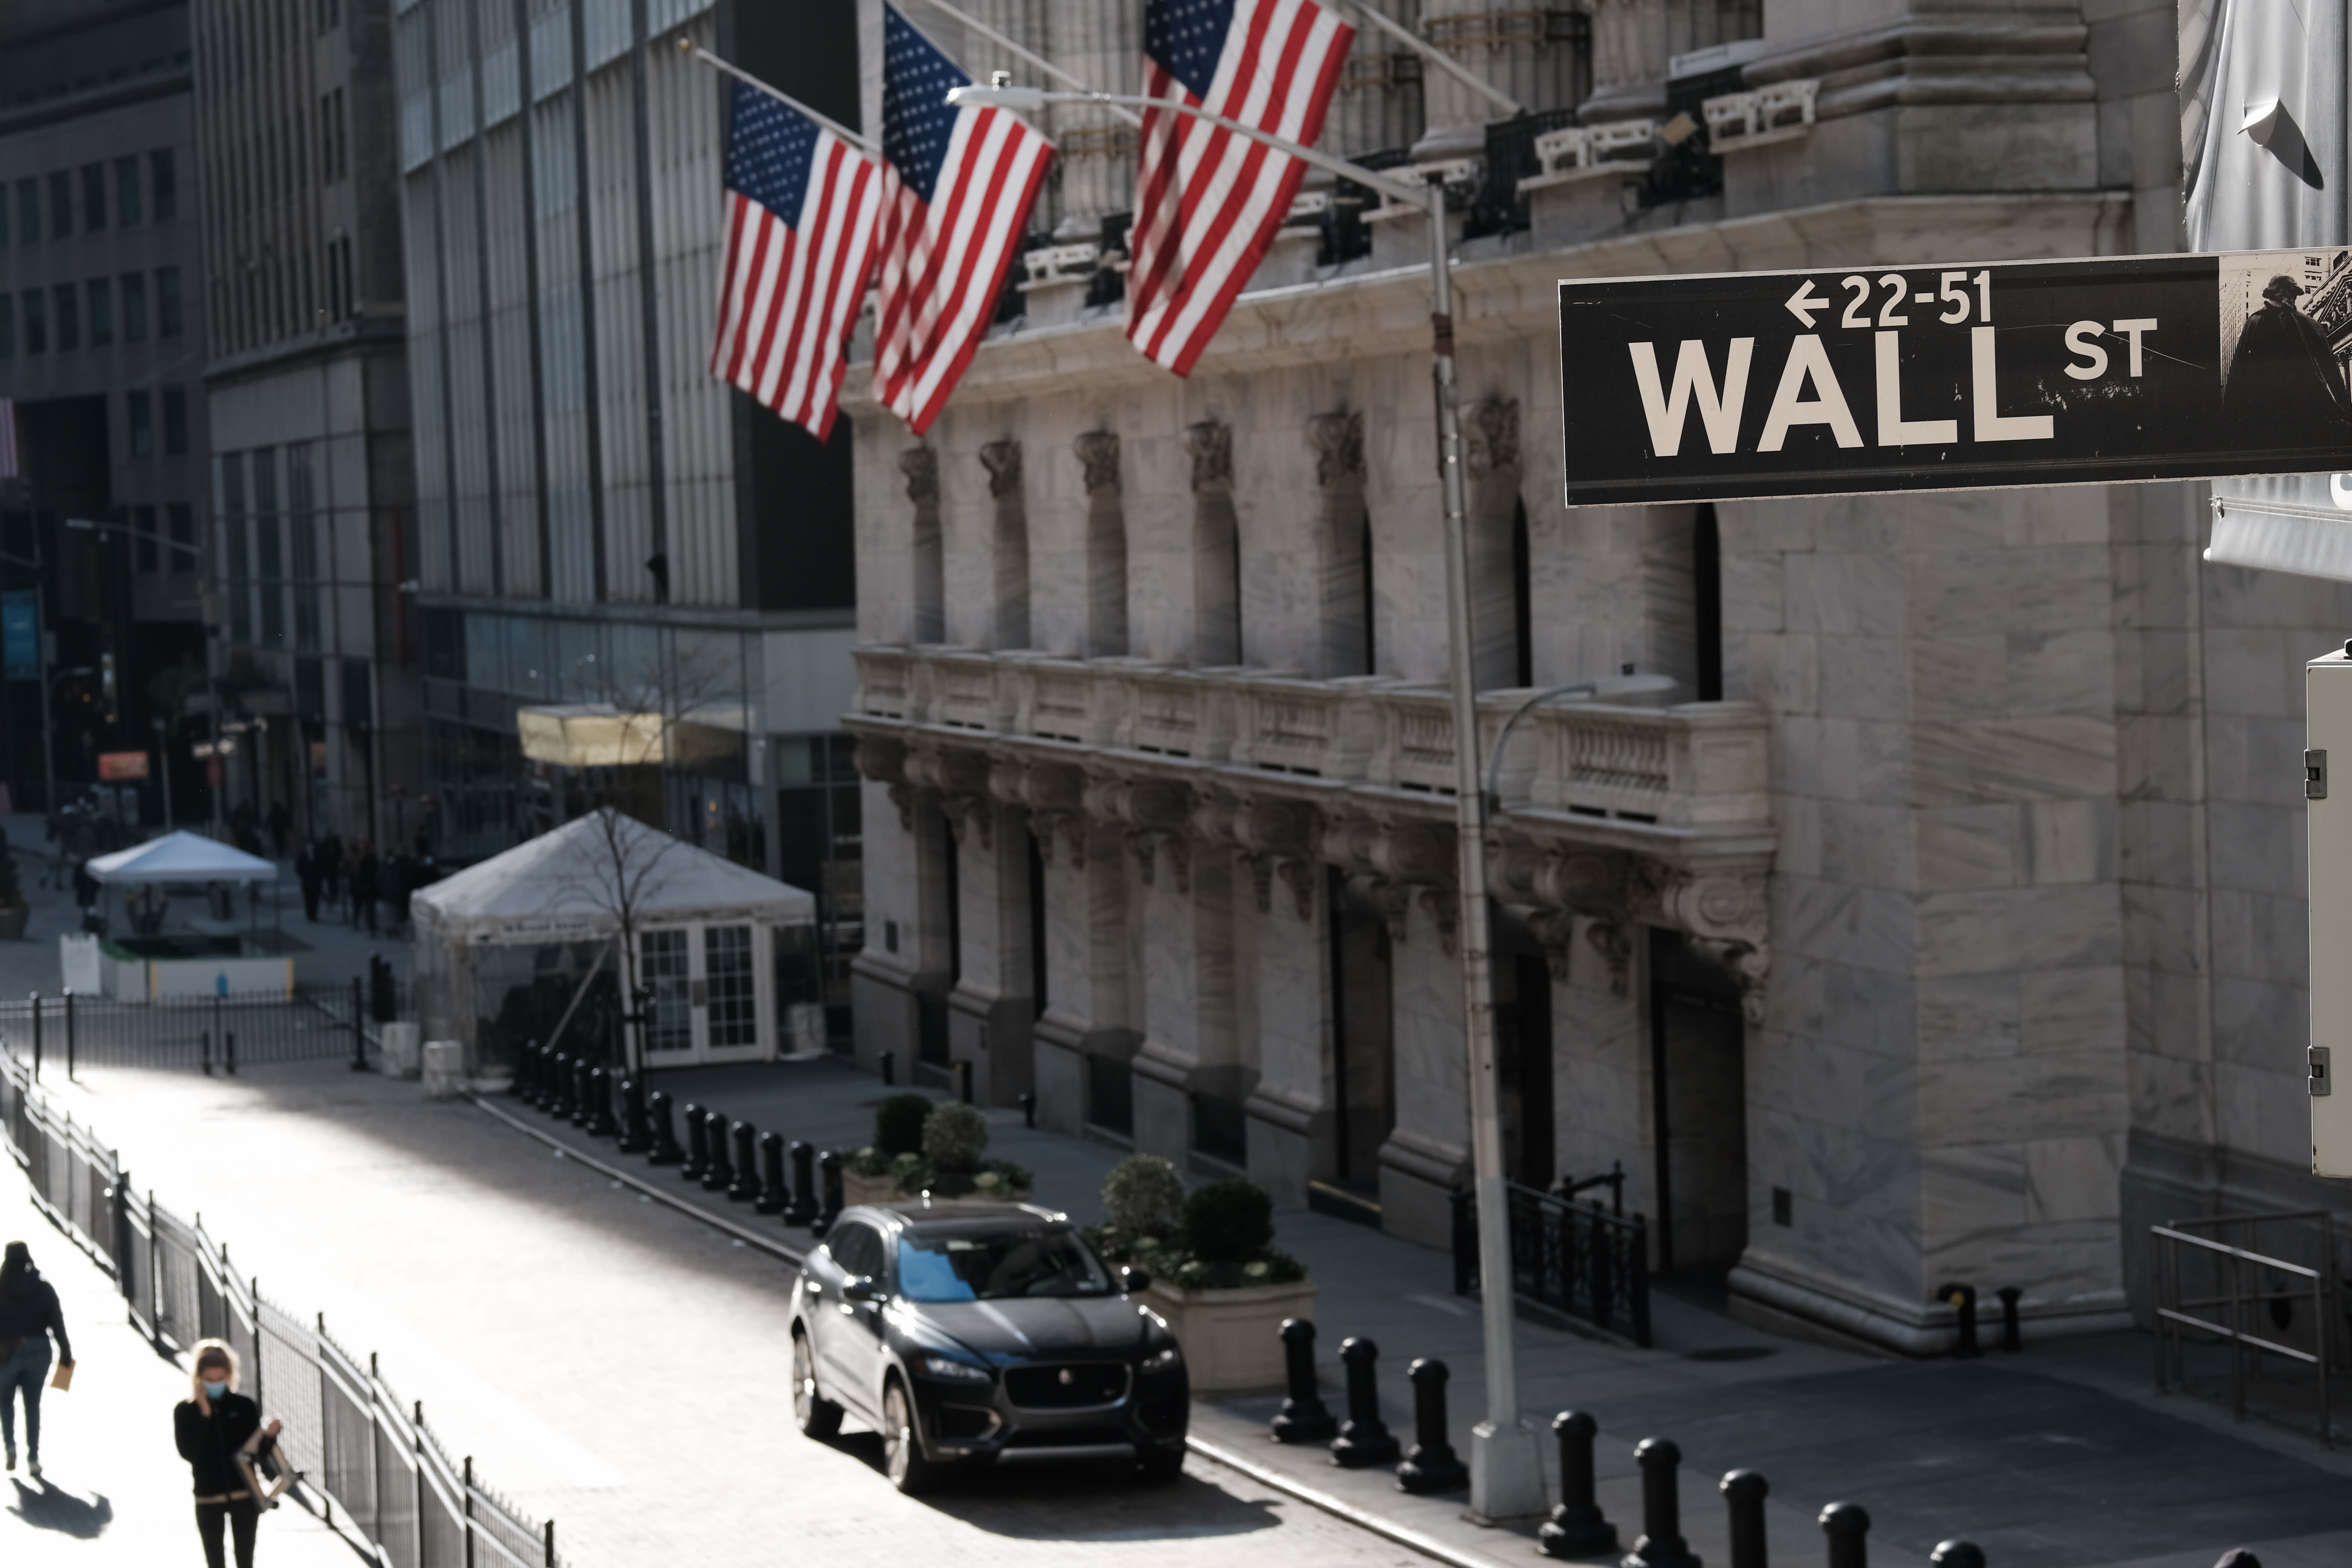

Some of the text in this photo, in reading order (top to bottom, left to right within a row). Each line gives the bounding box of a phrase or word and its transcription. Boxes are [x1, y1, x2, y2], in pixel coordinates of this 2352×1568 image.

[1841, 270, 1991, 328] 22-51
[1628, 318, 2158, 457] WALL ST
